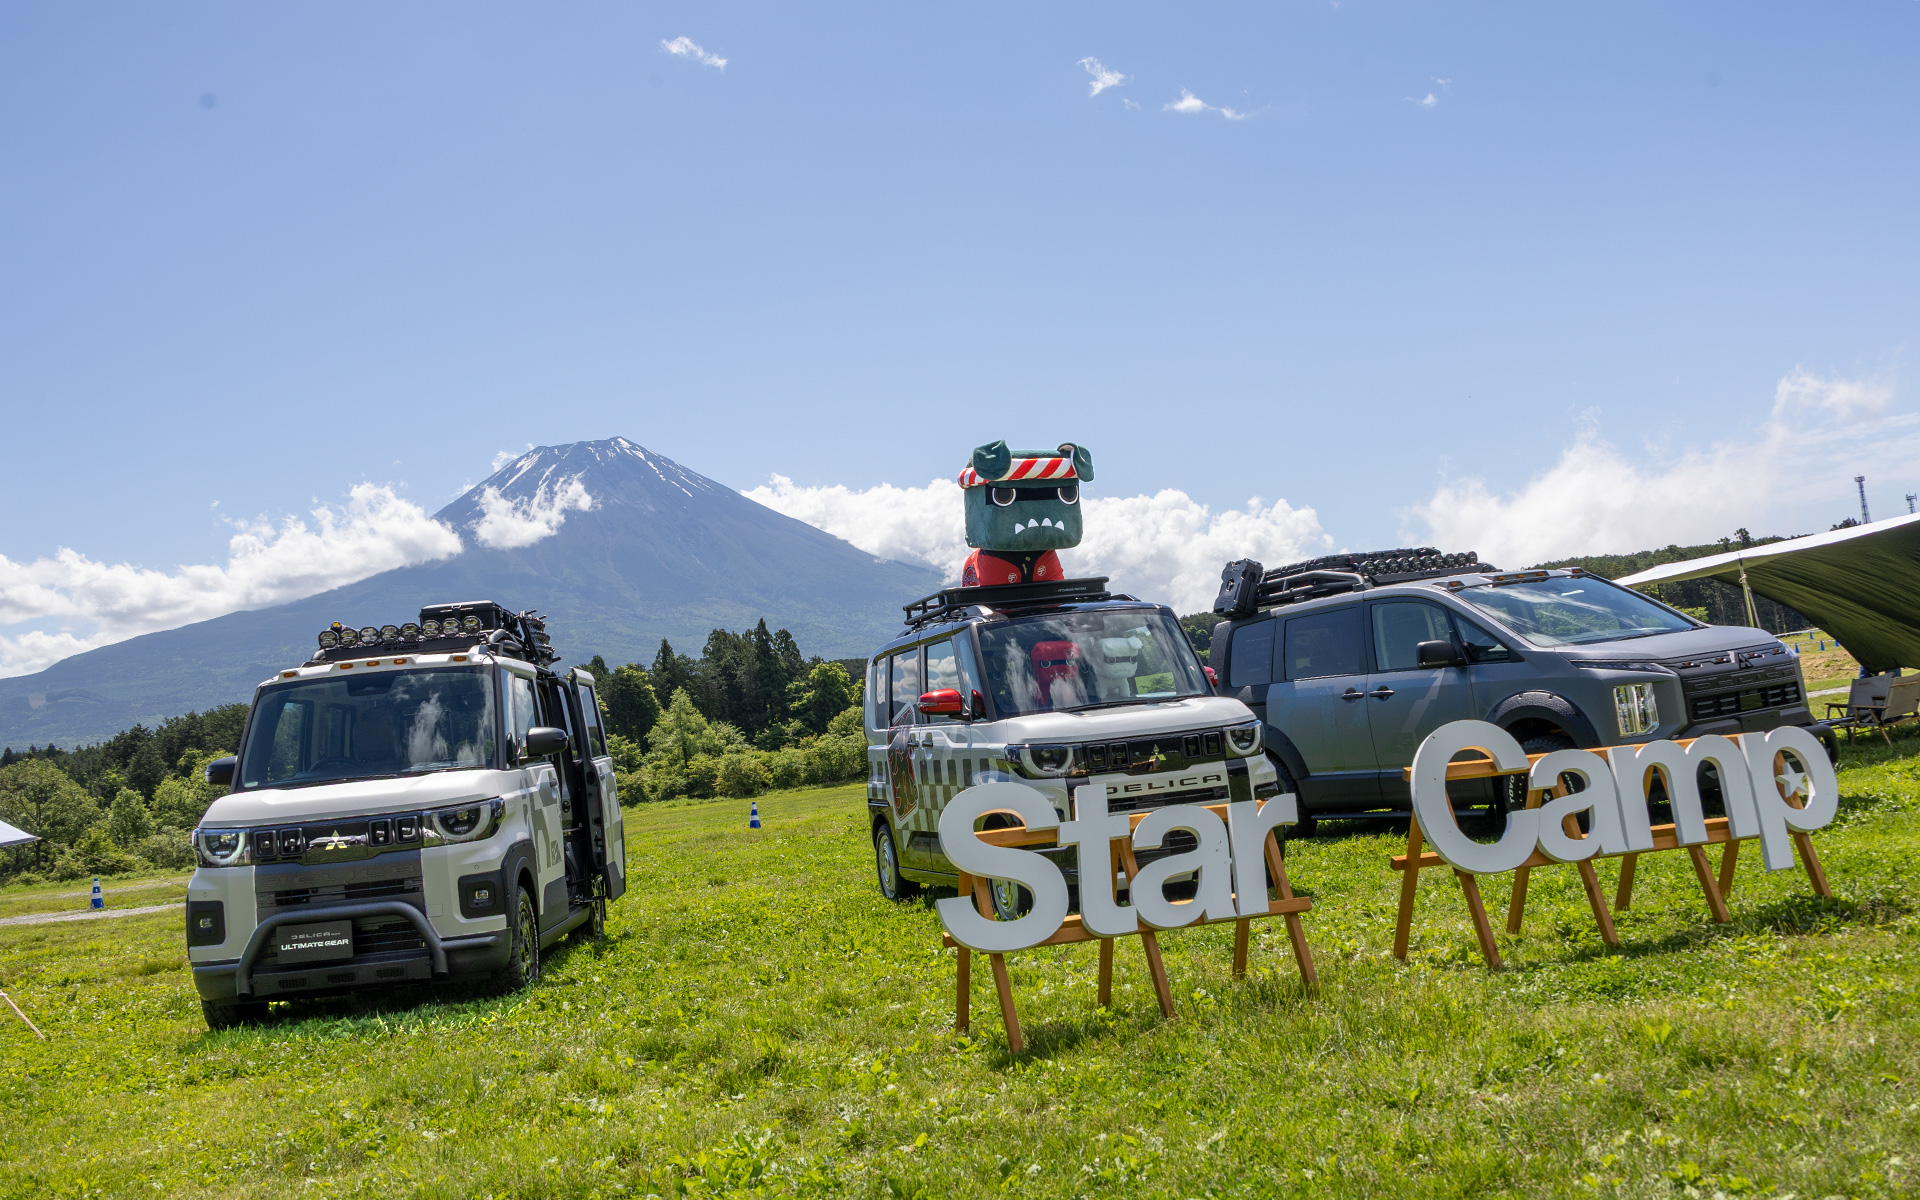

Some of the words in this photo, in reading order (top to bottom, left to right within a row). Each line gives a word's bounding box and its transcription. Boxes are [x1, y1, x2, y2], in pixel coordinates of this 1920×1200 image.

[1106, 774, 1222, 795] DELICA
[1508, 774, 1516, 804] TOYO
[935, 781, 1299, 954] Star
[1410, 719, 1839, 874] Camp
[281, 941, 324, 951] ULTIMATE
[324, 938, 350, 947] GEAR
